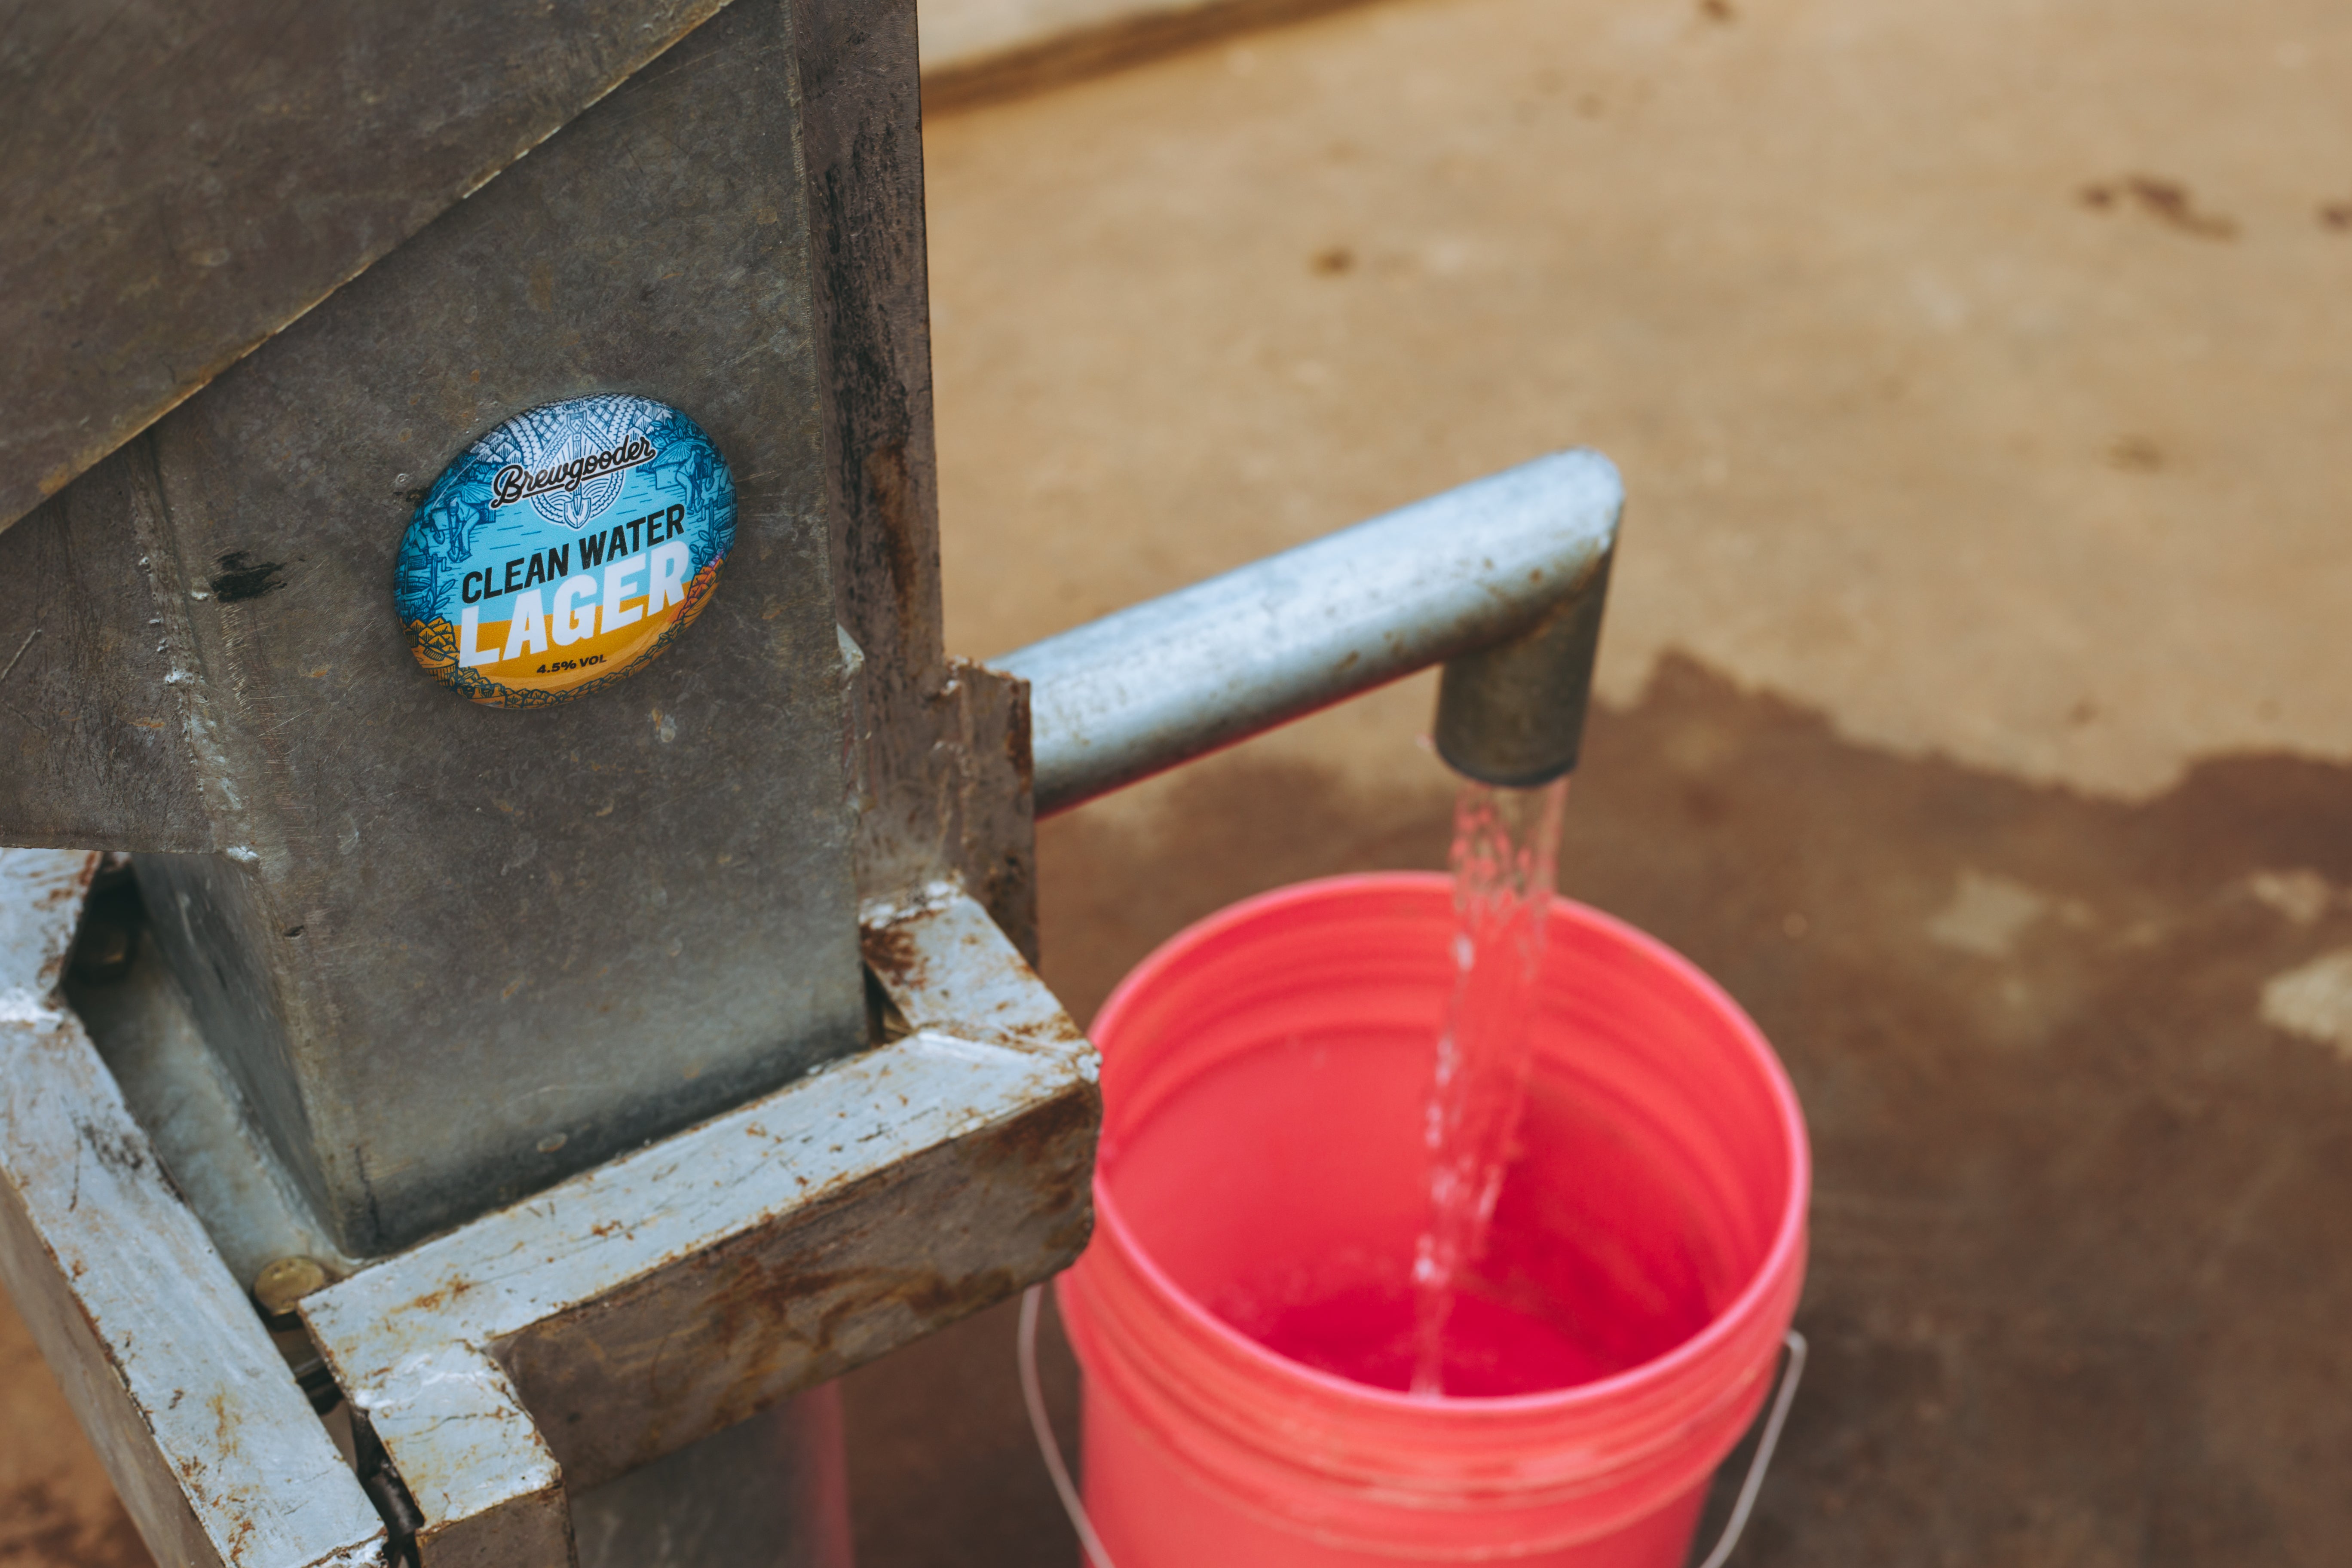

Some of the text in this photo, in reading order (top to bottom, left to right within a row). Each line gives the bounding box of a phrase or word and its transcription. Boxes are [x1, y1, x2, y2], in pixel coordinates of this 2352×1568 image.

[491, 435, 656, 508] Brewgooder
[462, 503, 686, 604] CLEAN WATER
[459, 541, 689, 668] LAGER
[536, 654, 607, 675] 4.5% VOL
